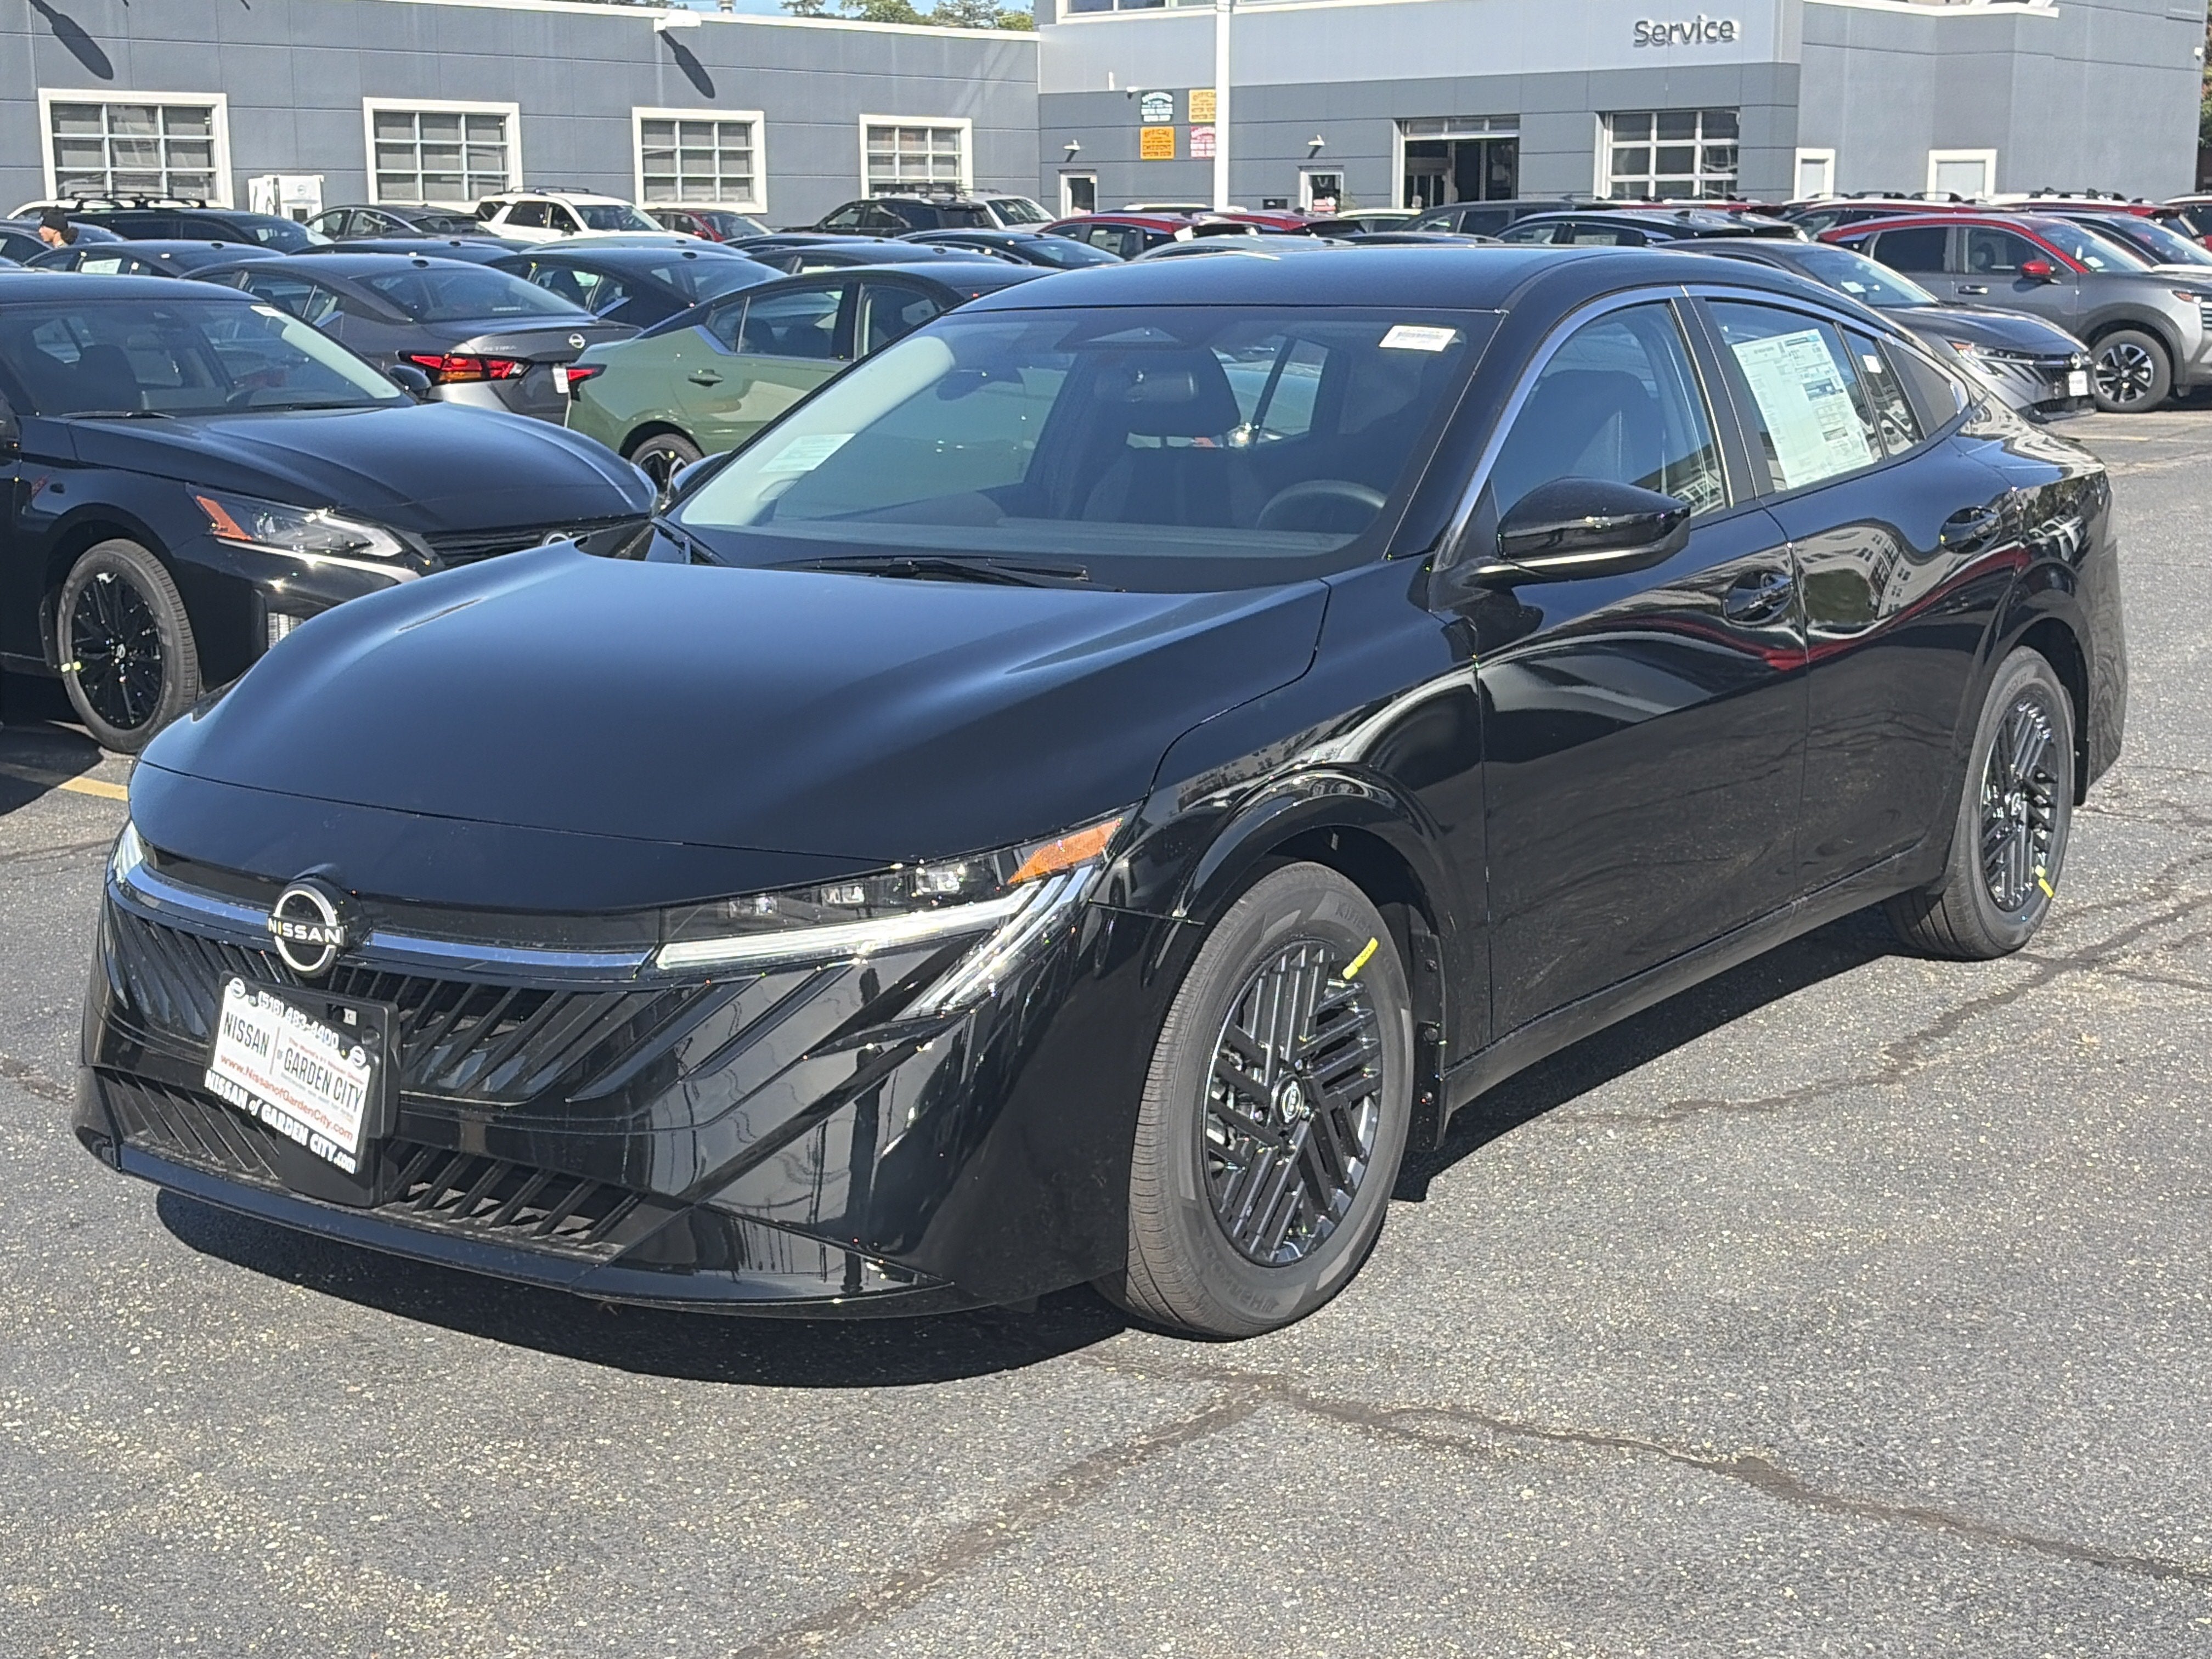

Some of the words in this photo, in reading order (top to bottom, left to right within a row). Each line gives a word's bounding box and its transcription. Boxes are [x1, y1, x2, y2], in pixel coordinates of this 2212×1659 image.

[1633, 14, 1735, 45] Service
[268, 917, 340, 944] NISSAN
[285, 1006, 338, 1050] 483-4400
[223, 1011, 269, 1058] NISSAN
[284, 1047, 332, 1096] GARDEN
[334, 1076, 363, 1113] CITY
[205, 1069, 249, 1110] NISSAN
[249, 1099, 263, 1116] of
[261, 1104, 308, 1146] GARDEN
[310, 1133, 356, 1174] CITY.com
[221, 1054, 353, 1141] www.NissanofGardenCity.com
